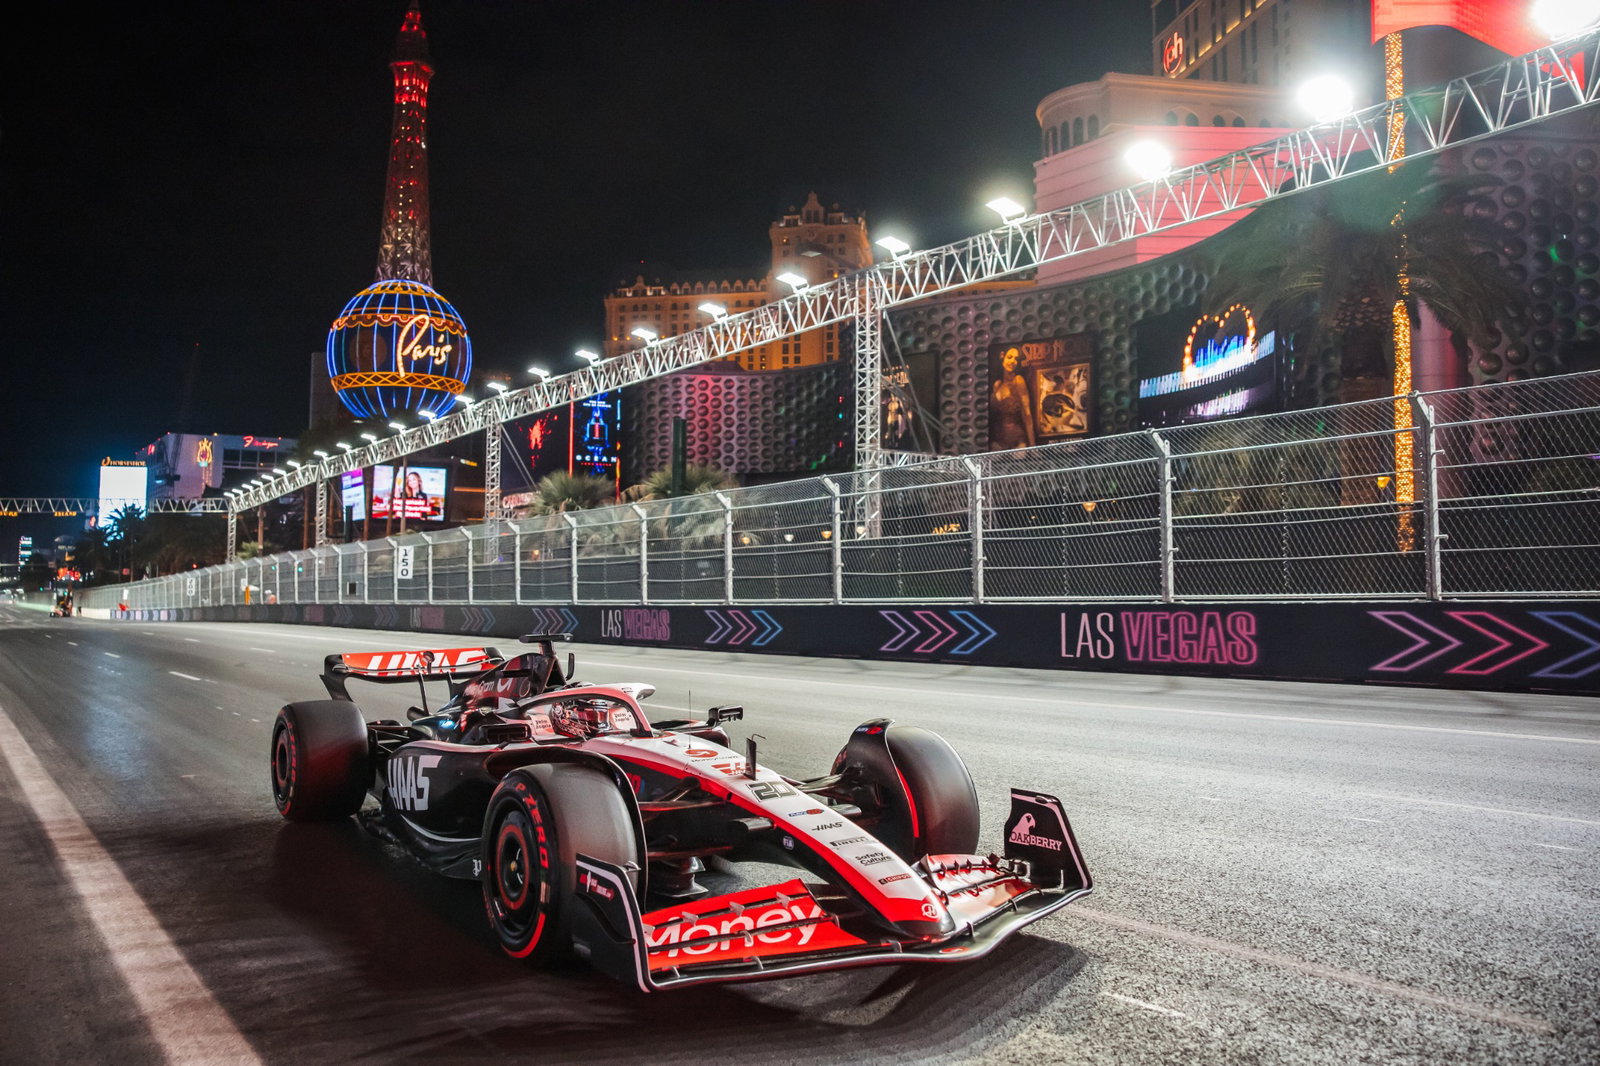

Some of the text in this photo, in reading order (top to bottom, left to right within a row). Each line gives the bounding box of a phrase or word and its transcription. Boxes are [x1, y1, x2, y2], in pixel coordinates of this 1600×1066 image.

[396, 314, 453, 378] Paris
[575, 455, 618, 463] OCEAN
[400, 548, 409, 577] 150
[601, 609, 671, 641] LAS VEGAS
[1061, 611, 1259, 666] LAS VEGAS
[388, 754, 443, 812] HAAS
[746, 780, 799, 803] 20
[515, 782, 549, 870] P ZERO
[783, 837, 794, 849] FIA
[830, 836, 869, 847] PIRELLI
[1009, 831, 1063, 852] OAKBERRY
[855, 851, 885, 861] Safety
[860, 855, 892, 866] Culture
[645, 904, 824, 958] Money
